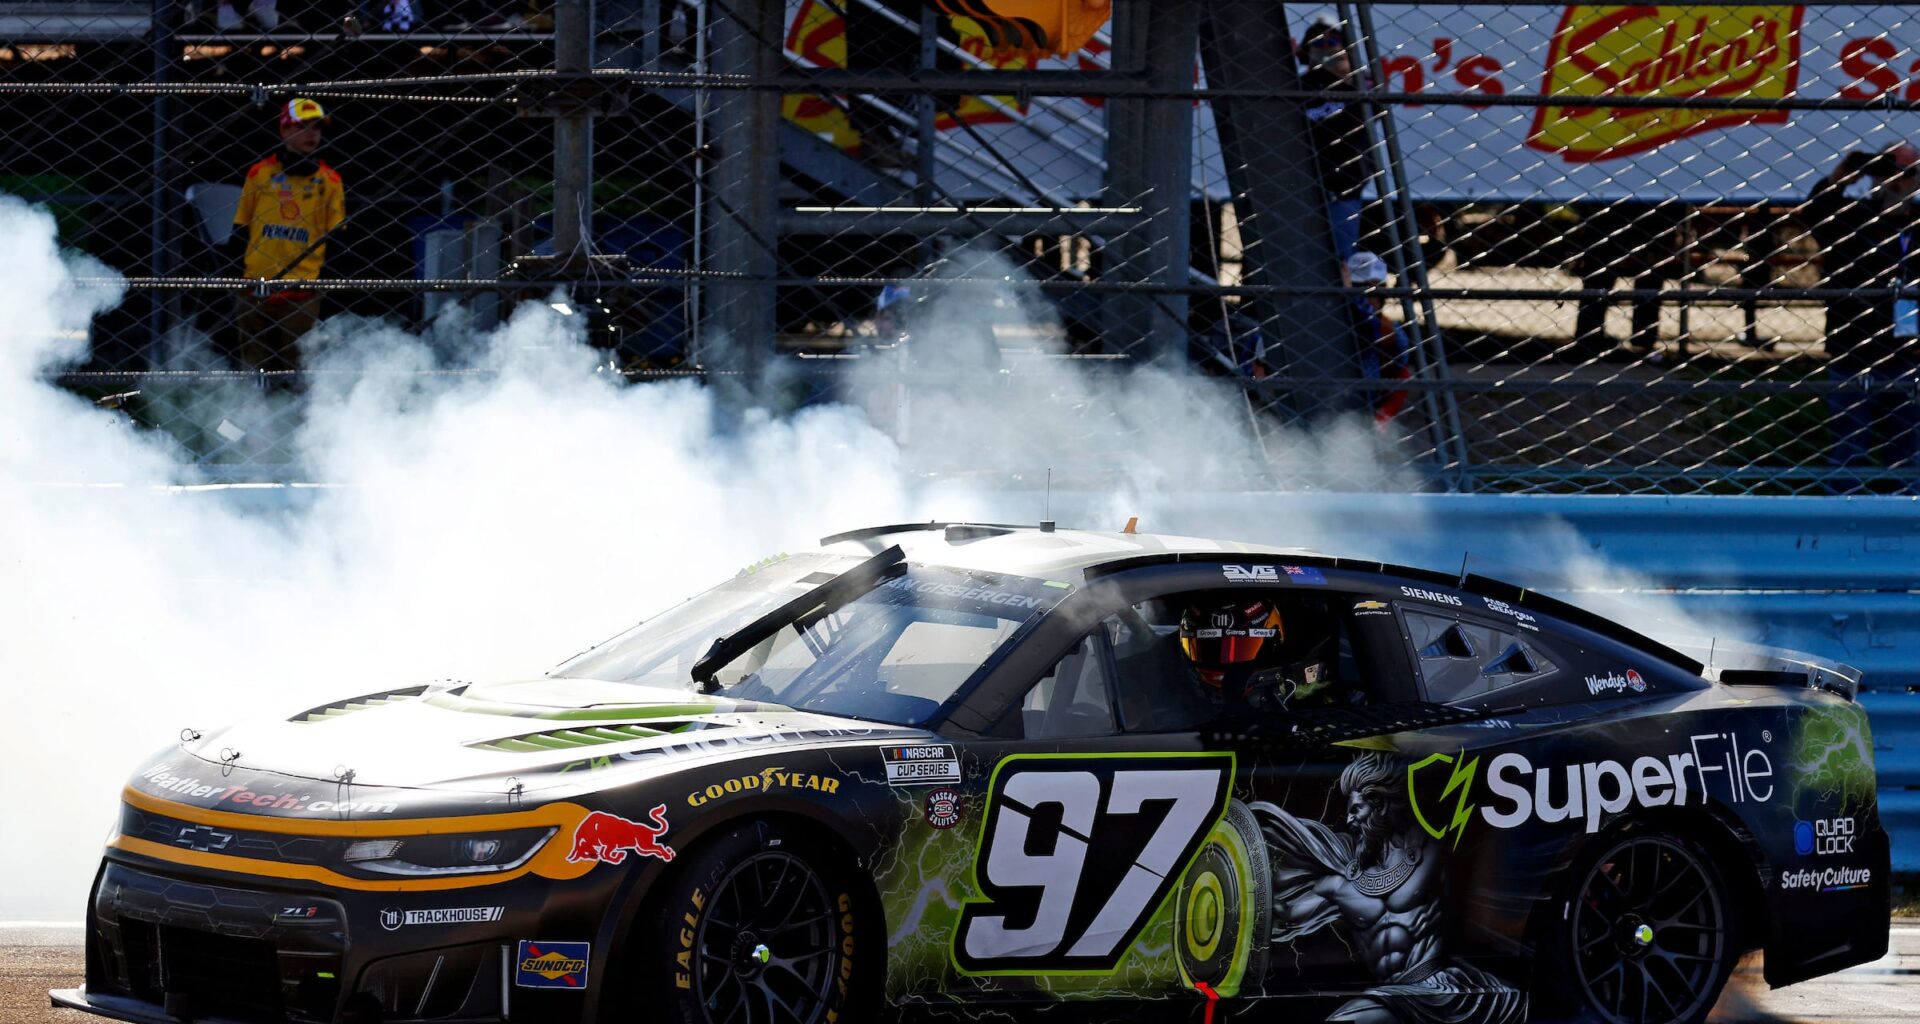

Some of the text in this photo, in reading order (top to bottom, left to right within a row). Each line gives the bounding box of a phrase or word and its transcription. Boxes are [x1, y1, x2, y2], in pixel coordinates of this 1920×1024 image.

[1222, 565, 1277, 580] SVG
[916, 582, 1044, 609] GISBERGEN
[1400, 586, 1463, 606] SIEMENS
[1584, 671, 1628, 695] Wendy's
[906, 747, 944, 759] NASCAR
[897, 763, 949, 776] CUP SERIES
[929, 792, 958, 804] NASCAR
[929, 812, 958, 826] SALUTES
[1816, 817, 1854, 836] QUAD
[1816, 836, 1854, 854] LOCK
[965, 769, 1221, 959] 97
[1781, 866, 1870, 892] SafetyCulture
[409, 908, 488, 923] TRACKHOUSE
[675, 888, 708, 989] EAGLE
[524, 958, 584, 973] SUNOCO
